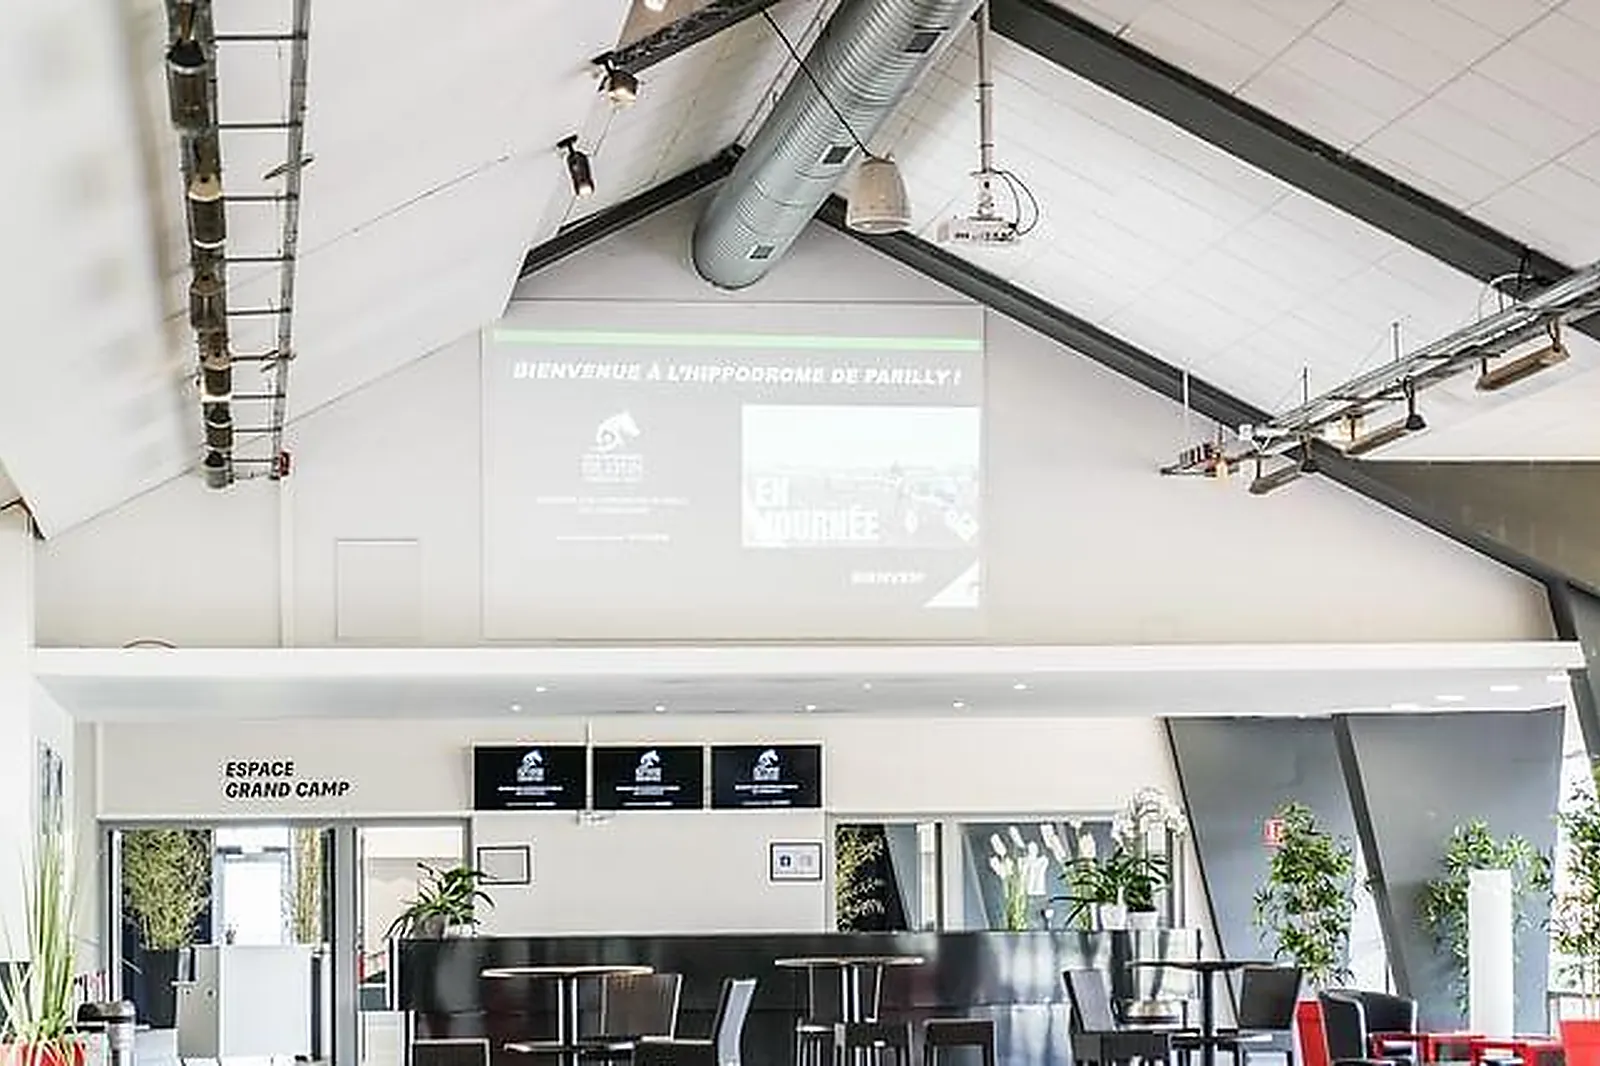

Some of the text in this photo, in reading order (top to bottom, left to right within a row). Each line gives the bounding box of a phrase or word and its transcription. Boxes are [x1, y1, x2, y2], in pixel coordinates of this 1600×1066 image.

[513, 361, 640, 380] BIENVENUE
[667, 363, 823, 384] L'HIPPODROME
[830, 366, 861, 384] DE
[226, 761, 294, 777] ESPACE
[225, 781, 350, 798] GRAND CAMP
